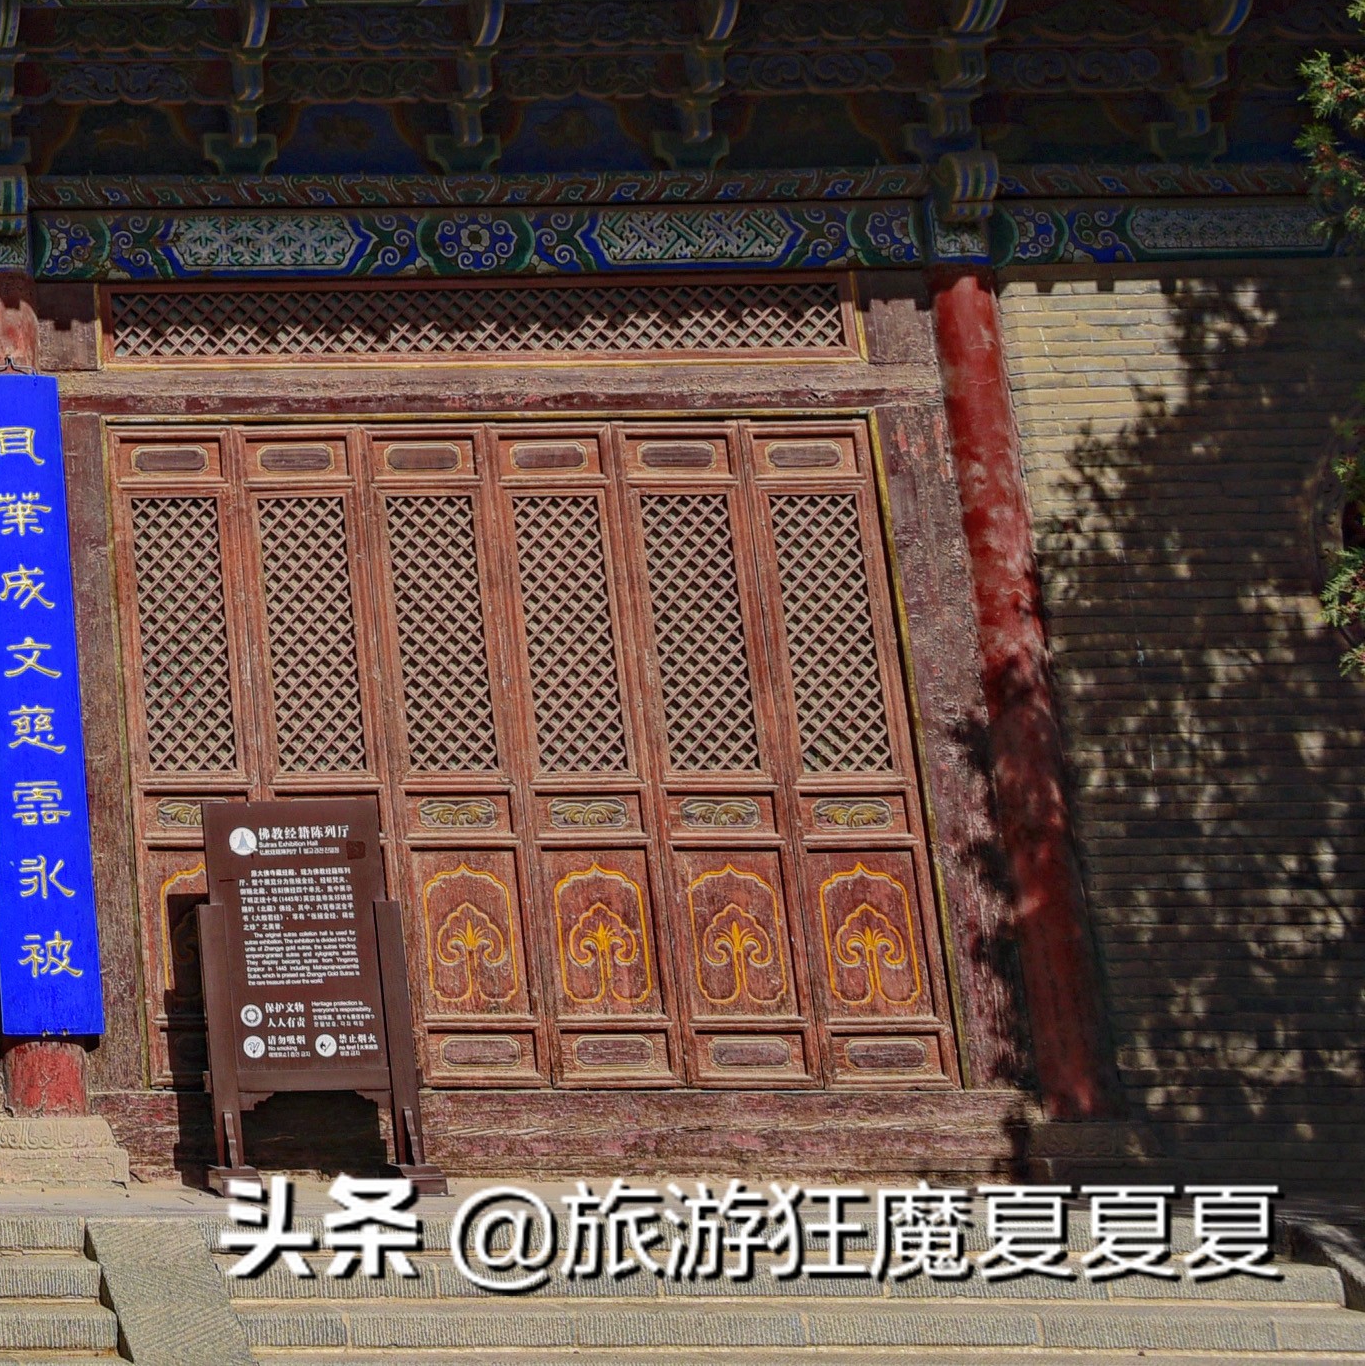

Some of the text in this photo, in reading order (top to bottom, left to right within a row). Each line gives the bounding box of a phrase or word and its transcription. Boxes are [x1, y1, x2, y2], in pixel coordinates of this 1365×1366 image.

[258, 824, 349, 841] 佛教经籍陈列厅
[265, 1001, 305, 1014] 保护文物
[267, 1016, 305, 1029] 人人有责
[267, 1035, 306, 1046] 请勿吸烟
[339, 1033, 377, 1044] 禁止烟火
